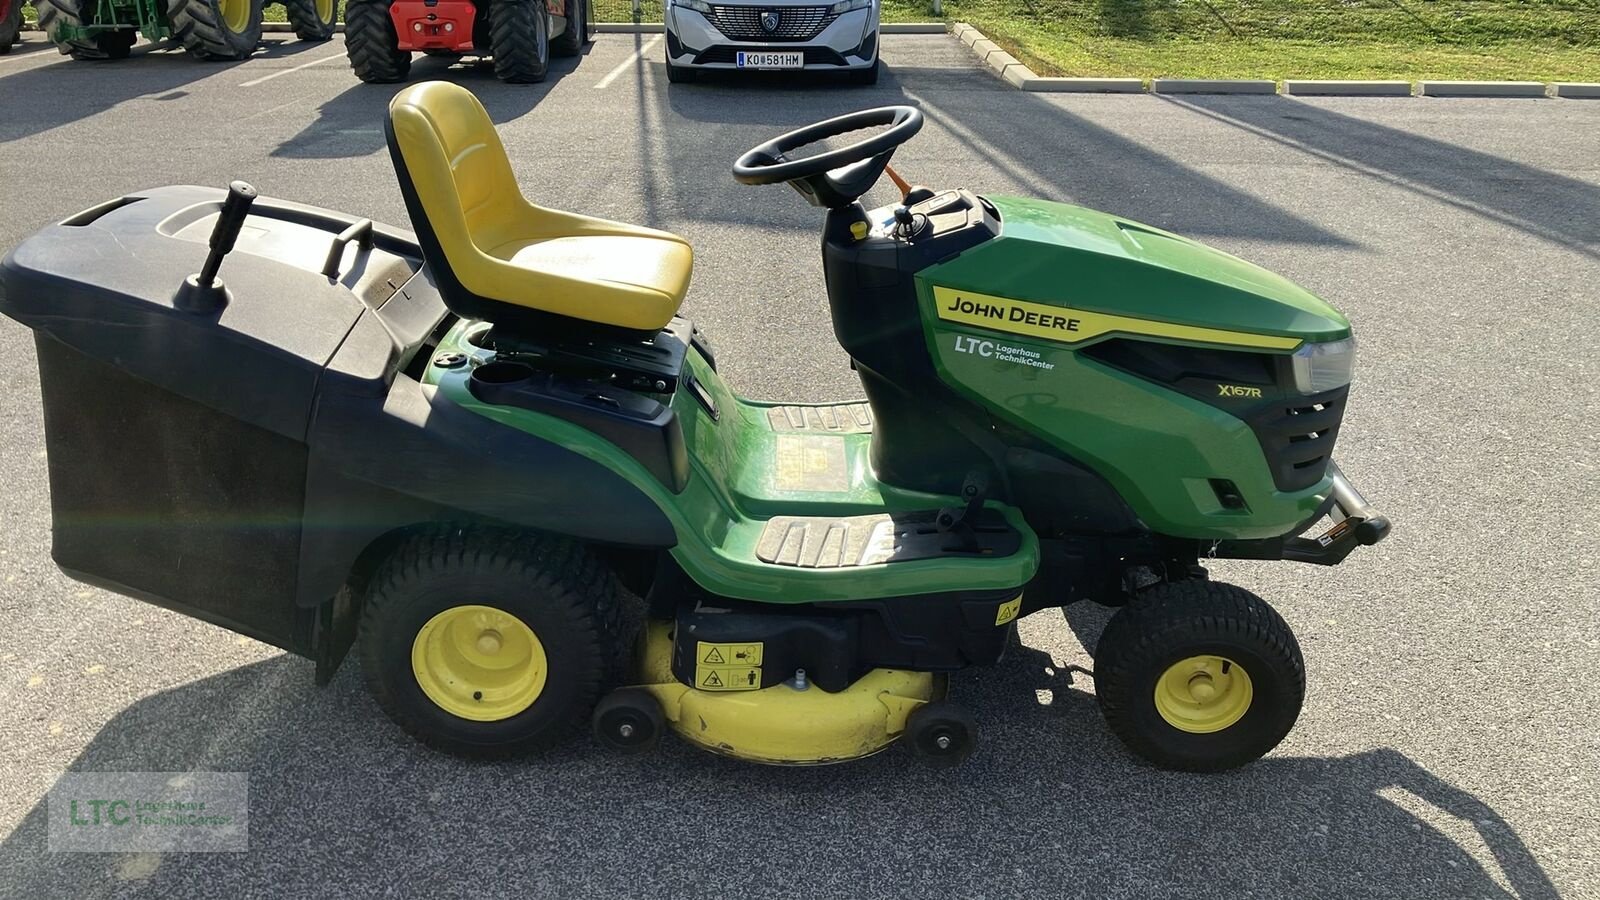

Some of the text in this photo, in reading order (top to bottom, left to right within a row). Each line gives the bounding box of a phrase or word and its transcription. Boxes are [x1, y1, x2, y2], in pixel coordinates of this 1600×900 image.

[948, 297, 1080, 331] JOHN DEERE
[954, 336, 994, 357] LTC
[996, 344, 1041, 359] Lagerhaus
[995, 352, 1055, 370] TechnikCenter
[1217, 384, 1262, 398] X167R
